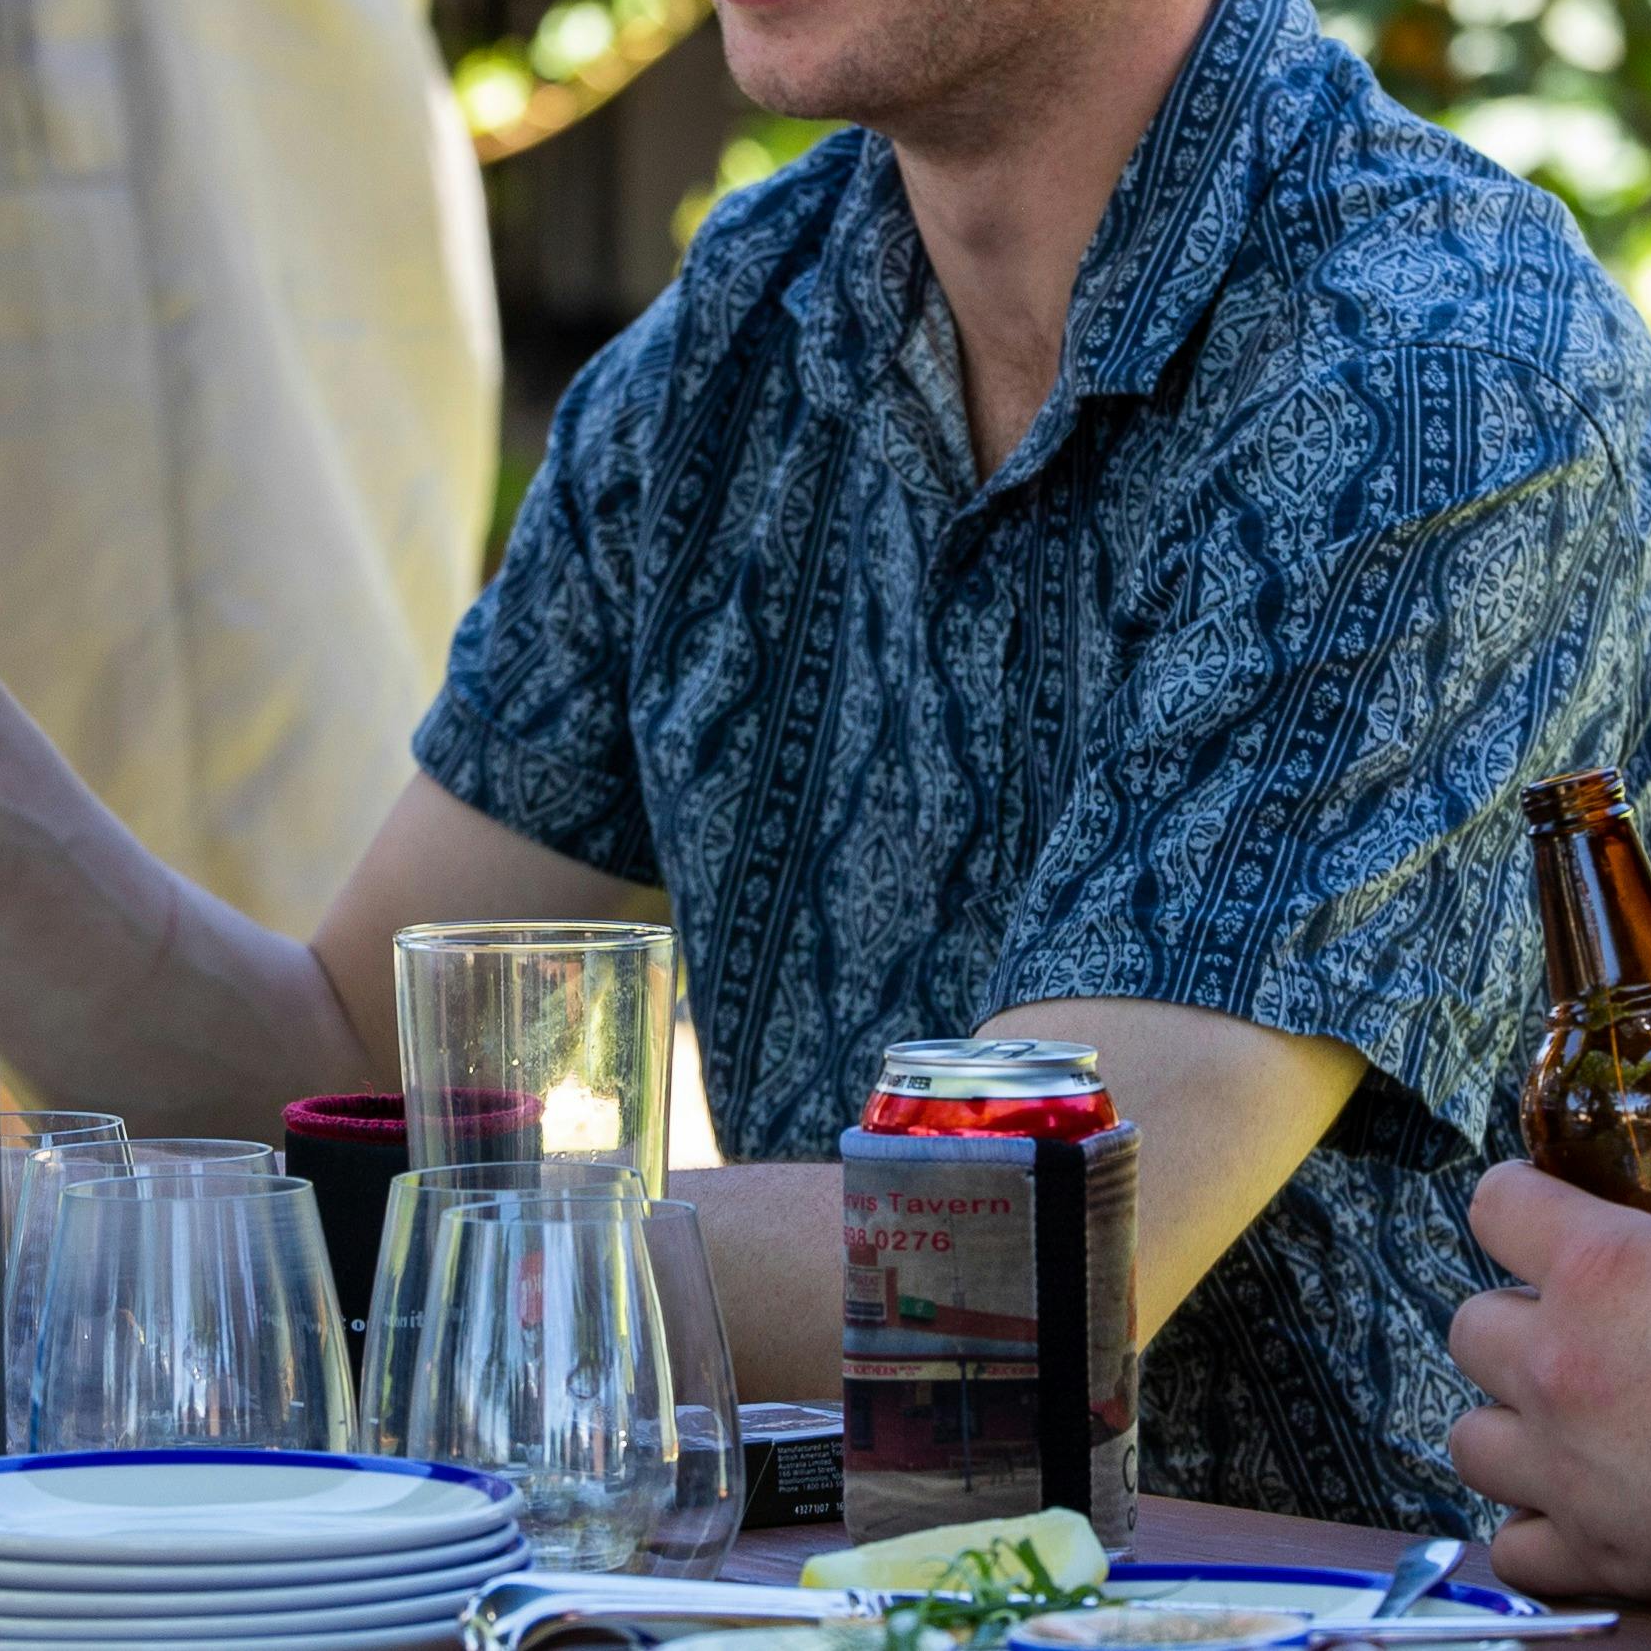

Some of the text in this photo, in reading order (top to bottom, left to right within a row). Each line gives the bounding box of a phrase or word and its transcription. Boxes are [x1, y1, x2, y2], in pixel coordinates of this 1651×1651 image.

[887, 1193, 1011, 1214] Tavern
[875, 1230, 951, 1252] 0276
[777, 1444, 822, 1454] Manufactured
[800, 1451, 830, 1460] American
[778, 1461, 807, 1470] Australia
